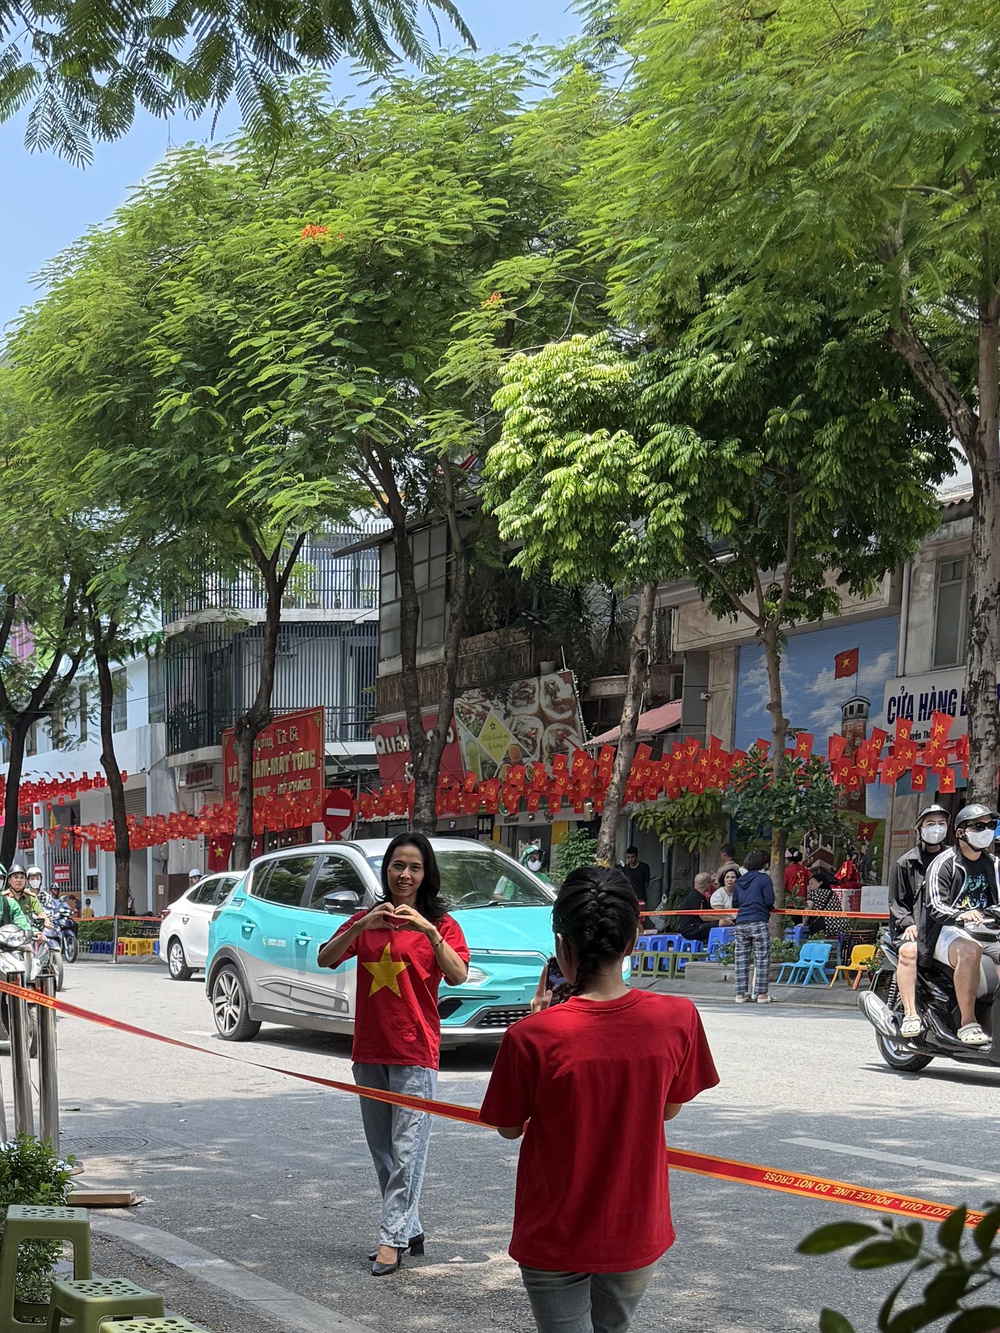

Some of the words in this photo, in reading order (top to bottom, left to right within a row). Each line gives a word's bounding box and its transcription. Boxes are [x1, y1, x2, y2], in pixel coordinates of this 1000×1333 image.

[887, 685, 914, 725] CỬA
[918, 686, 958, 722] HÀNG
[227, 761, 239, 786] VẬ
[291, 747, 317, 772] TÔNG
[763, 1171, 795, 1185] CROSS
[794, 1179, 816, 1190] NOT
[815, 1183, 831, 1193] DO
[855, 1191, 894, 1206] POLICE
[899, 1200, 923, 1211] QUA
